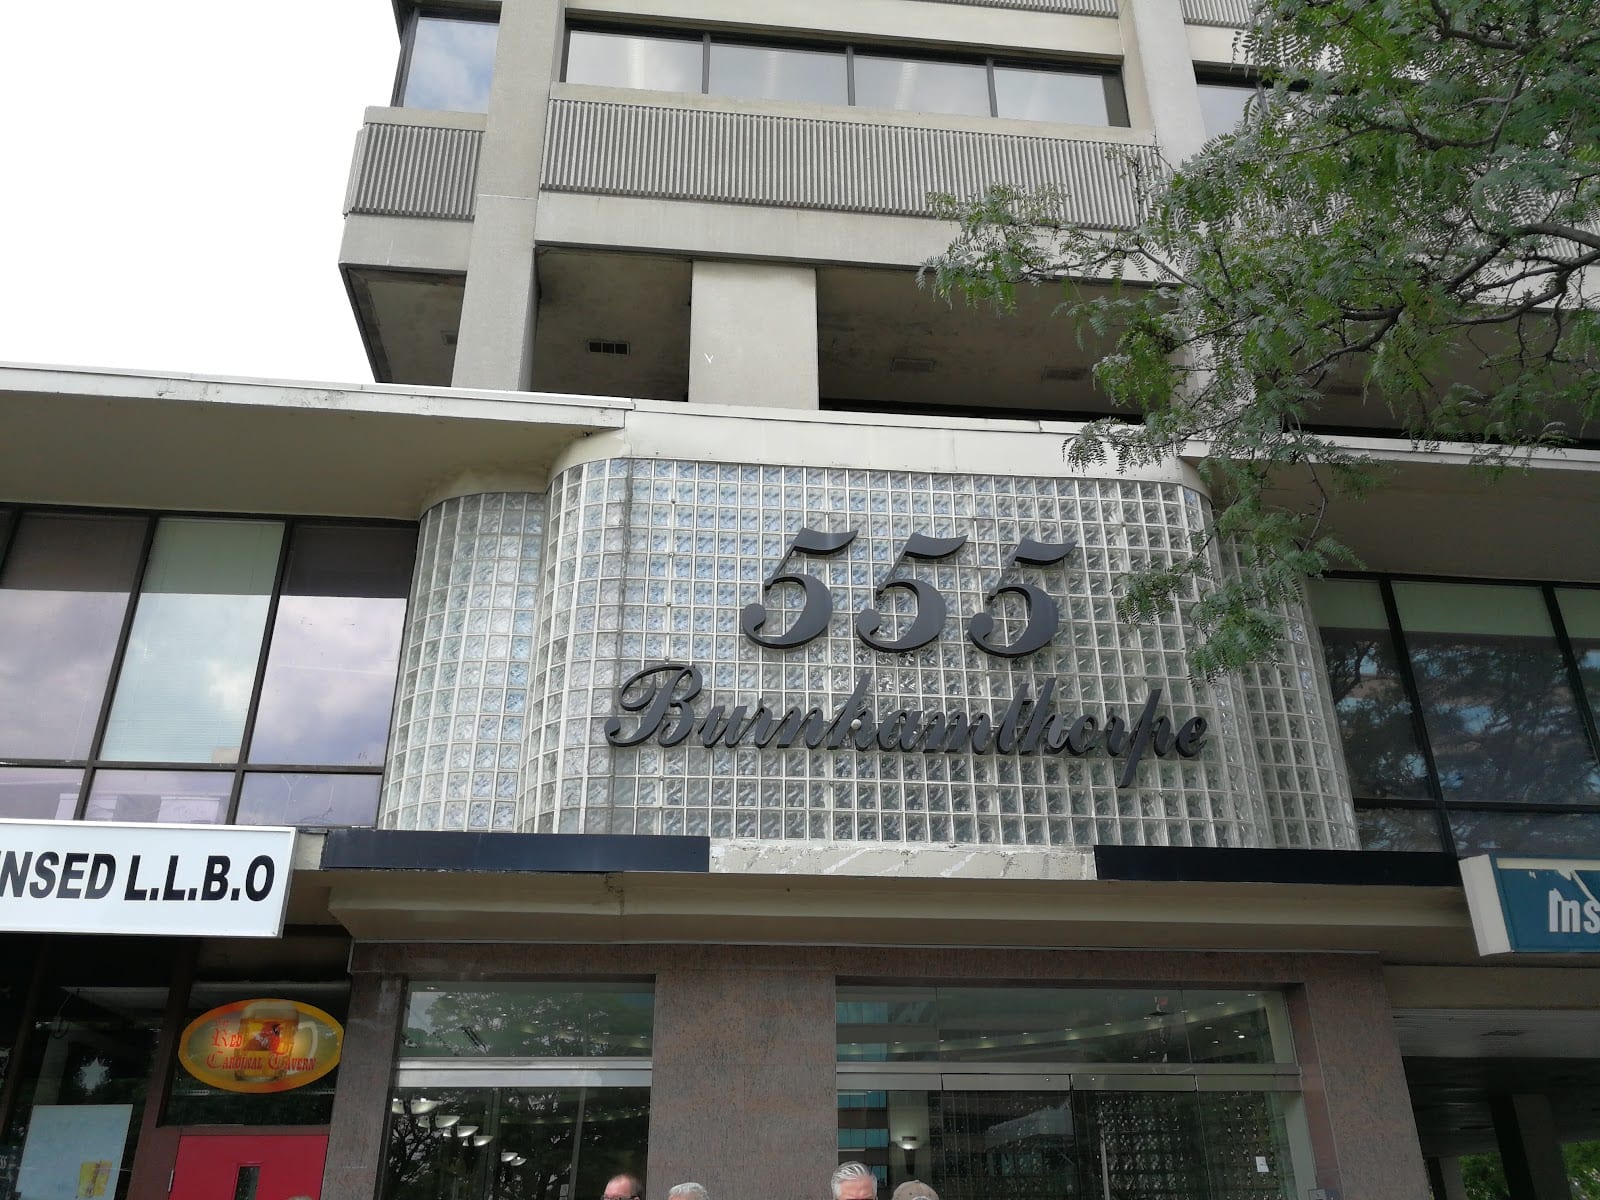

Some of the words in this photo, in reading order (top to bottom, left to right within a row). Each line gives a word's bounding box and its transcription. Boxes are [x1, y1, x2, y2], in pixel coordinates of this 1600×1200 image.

[741, 528, 1077, 658] 555
[604, 663, 1209, 788] Burnhamthorpe
[124, 854, 275, 902] L.L.B.O
